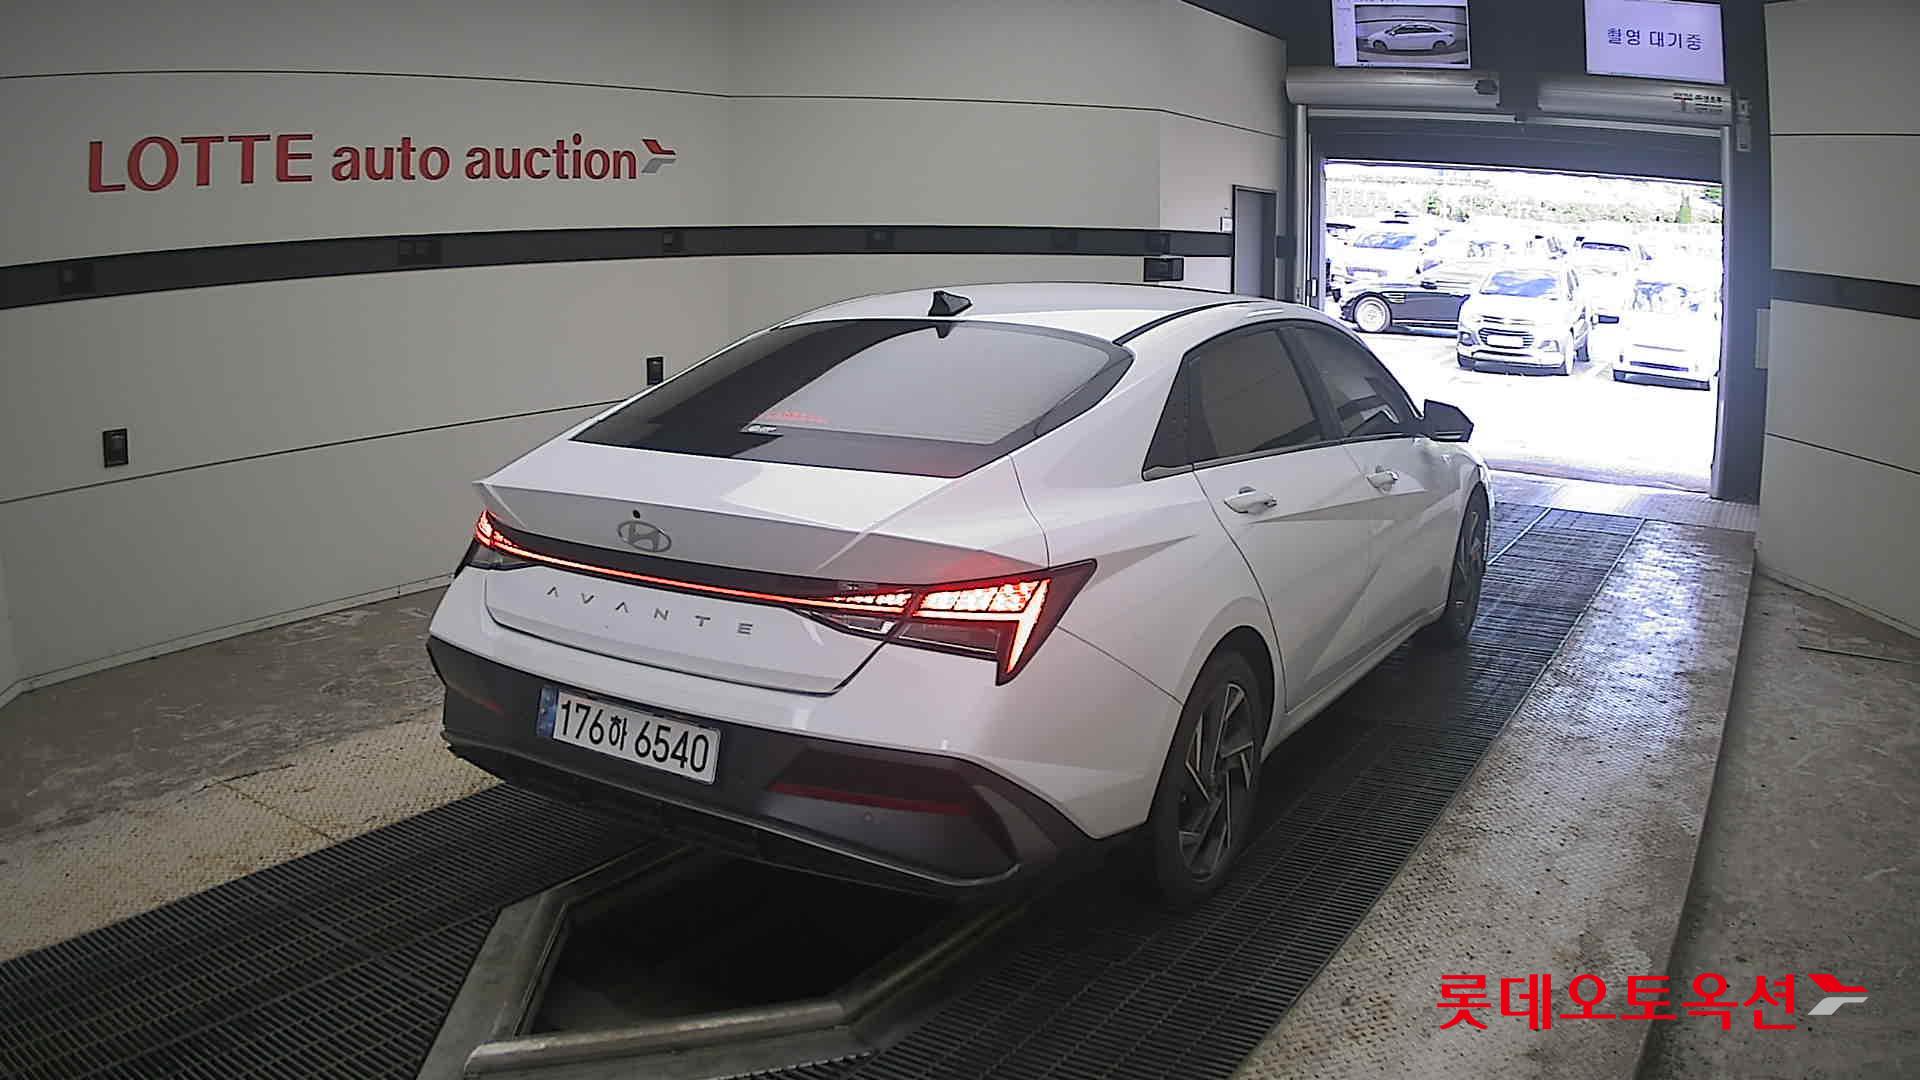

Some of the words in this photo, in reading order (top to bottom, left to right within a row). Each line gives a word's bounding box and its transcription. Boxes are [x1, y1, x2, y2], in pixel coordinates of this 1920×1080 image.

[1649, 31, 1702, 51] 대기중
[88, 133, 315, 194] LOTTE
[331, 136, 451, 181] auto
[464, 133, 638, 180] auction
[546, 586, 754, 636] AVANTE
[560, 699, 628, 751] 176하
[634, 720, 709, 773] 6540
